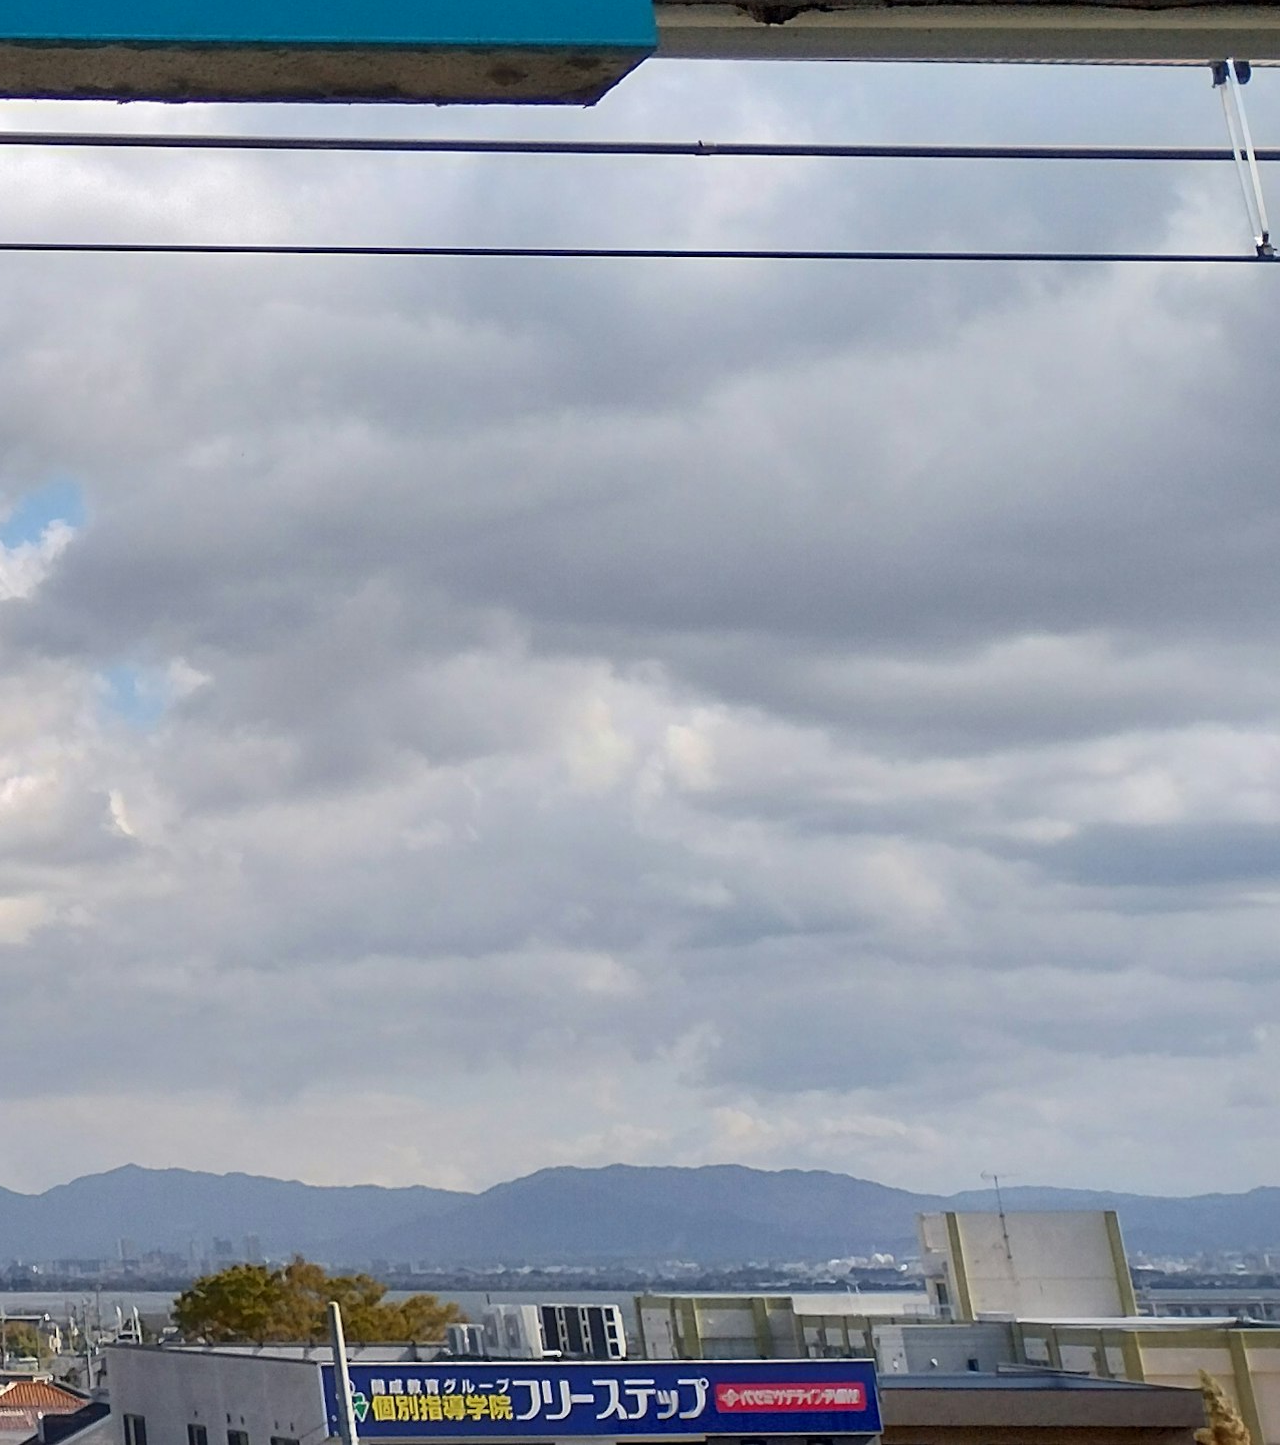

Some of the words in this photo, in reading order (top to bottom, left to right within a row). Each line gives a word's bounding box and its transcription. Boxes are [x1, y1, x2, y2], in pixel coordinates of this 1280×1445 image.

[371, 1394, 514, 1422] 個別指導学院
[512, 1377, 709, 1420] フリーステップ
